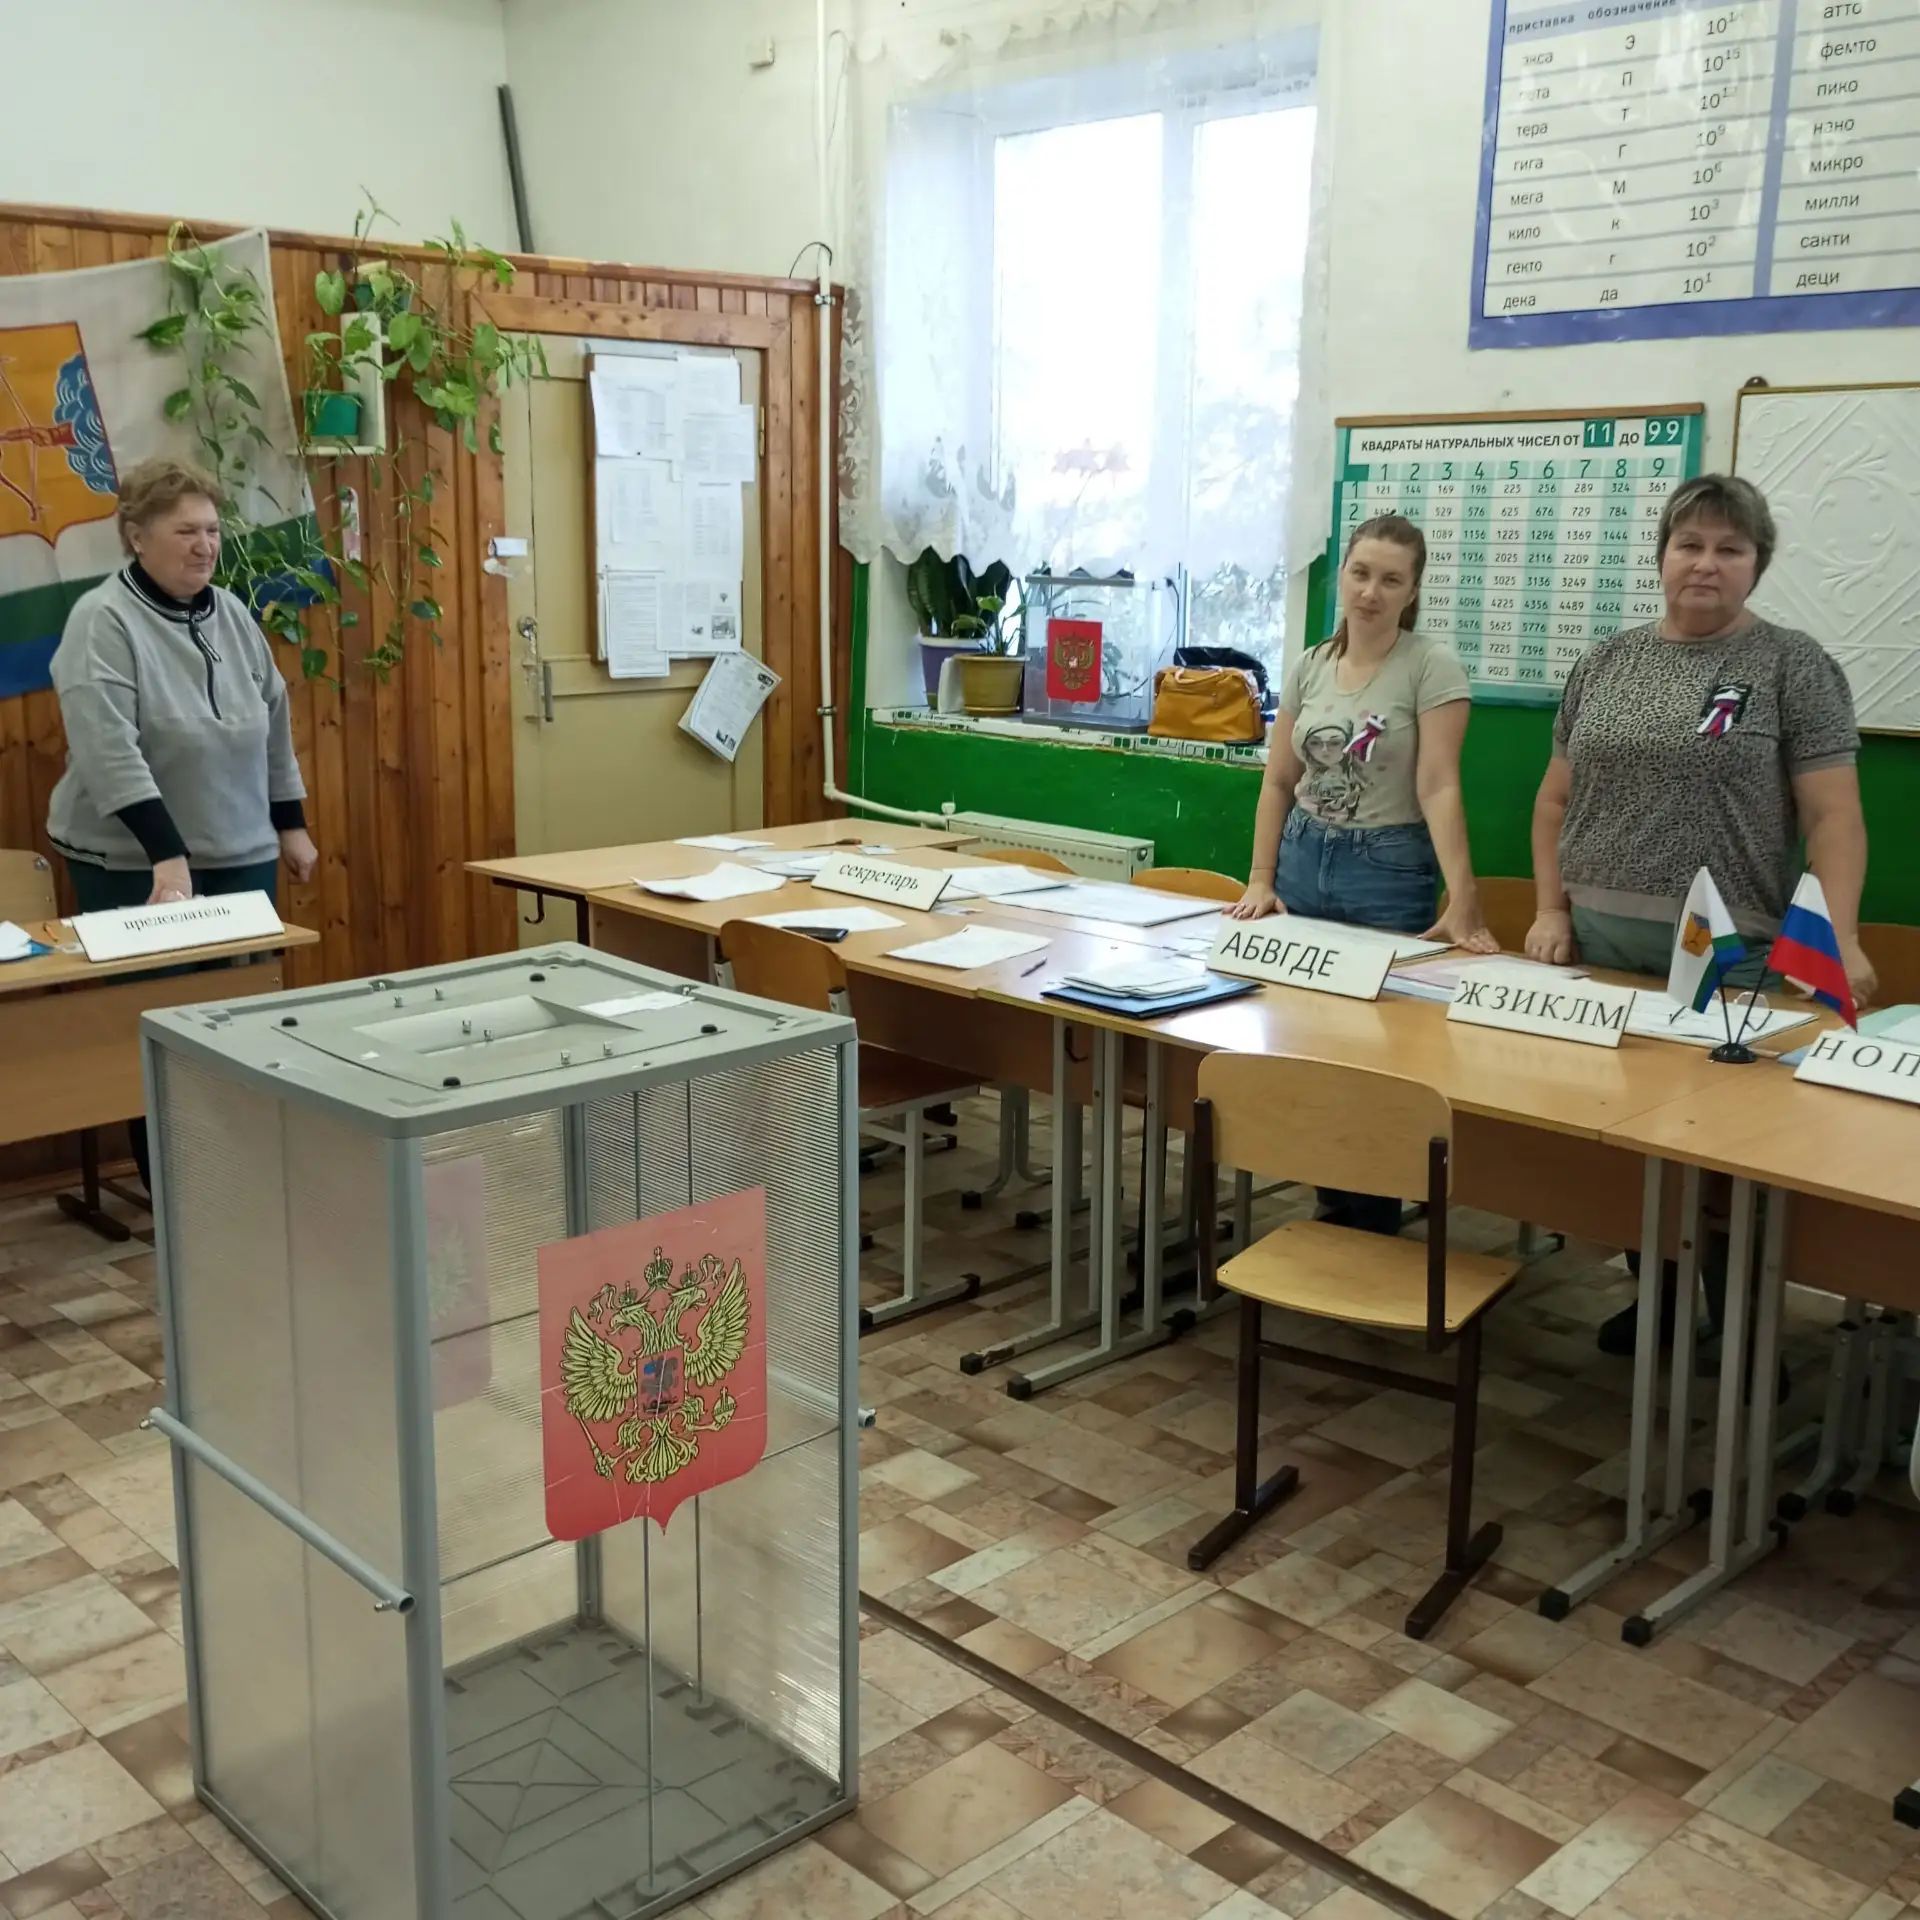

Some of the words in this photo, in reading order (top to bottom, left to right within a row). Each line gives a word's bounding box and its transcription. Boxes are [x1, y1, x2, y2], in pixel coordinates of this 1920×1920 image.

[1509, 14, 1575, 35] приставка
[1625, 34, 1636, 50] Э
[1820, 38, 1877, 61] фемто
[1622, 71, 1633, 87] П
[1817, 79, 1859, 97] пико
[1516, 122, 1548, 138] тера
[1513, 158, 1544, 172] гига
[1618, 143, 1627, 159] Г
[1808, 155, 1864, 176] микро
[1510, 191, 1544, 206] мега
[1612, 180, 1626, 195] М
[1804, 193, 1860, 212] милли
[1508, 226, 1541, 241] кило
[1800, 231, 1851, 249] санти
[1506, 260, 1543, 275] гекто
[1796, 270, 1840, 289] деци
[1502, 294, 1536, 311] дека
[1599, 288, 1618, 303] да
[1361, 439, 1423, 452] КВАДРАТЫ
[1425, 436, 1515, 450] НАТУРАЛЬНЫХ
[1517, 434, 1560, 447] ЧИСЕЛ
[1563, 434, 1580, 446] ОТ
[1586, 422, 1612, 444] 11
[1618, 432, 1640, 447] ДО
[1647, 419, 1680, 443] 99
[1380, 463, 1388, 481] 1
[1409, 462, 1421, 481] 2
[1441, 462, 1453, 480] 3
[1474, 461, 1484, 480] 4
[1508, 460, 1520, 480] 5
[1543, 459, 1555, 479] 6
[1580, 459, 1592, 478] 7
[1615, 458, 1627, 478] 8
[1652, 457, 1665, 477] 9
[1351, 480, 1359, 499] 1
[1376, 485, 1391, 495] 121
[1405, 484, 1422, 494] 144
[1438, 484, 1454, 494] 169
[1470, 484, 1487, 494] 196
[1503, 484, 1521, 494] 225
[1537, 483, 1556, 494] 256
[1573, 483, 1593, 493] 289
[1611, 482, 1630, 493] 324
[1648, 481, 1667, 493] 361
[1349, 503, 1359, 521] 2
[1468, 507, 1485, 517] 576
[1501, 507, 1519, 517] 625
[1535, 506, 1554, 517] 676
[1572, 507, 1591, 517] 729
[1609, 506, 1628, 517] 784
[1497, 530, 1520, 540] 1225
[1531, 530, 1554, 541] 1296
[1567, 530, 1592, 541] 1369
[1604, 531, 1628, 541] 1444
[1495, 553, 1518, 563] 2025
[1528, 553, 1553, 564] 2116
[1563, 554, 1590, 564] 2209
[1600, 555, 1625, 565] 2304
[1561, 577, 1586, 588] 3249
[1597, 578, 1623, 589] 3364
[1635, 579, 1660, 590] 3481
[1524, 600, 1548, 610] 4356
[1559, 601, 1584, 612] 4489
[1596, 602, 1621, 612] 4624
[1632, 603, 1659, 614] 4761
[1557, 624, 1583, 635] 5929
[837, 860, 921, 892] секретарь
[123, 904, 231, 932] председатель
[1220, 930, 1341, 980] АБВГДЕ
